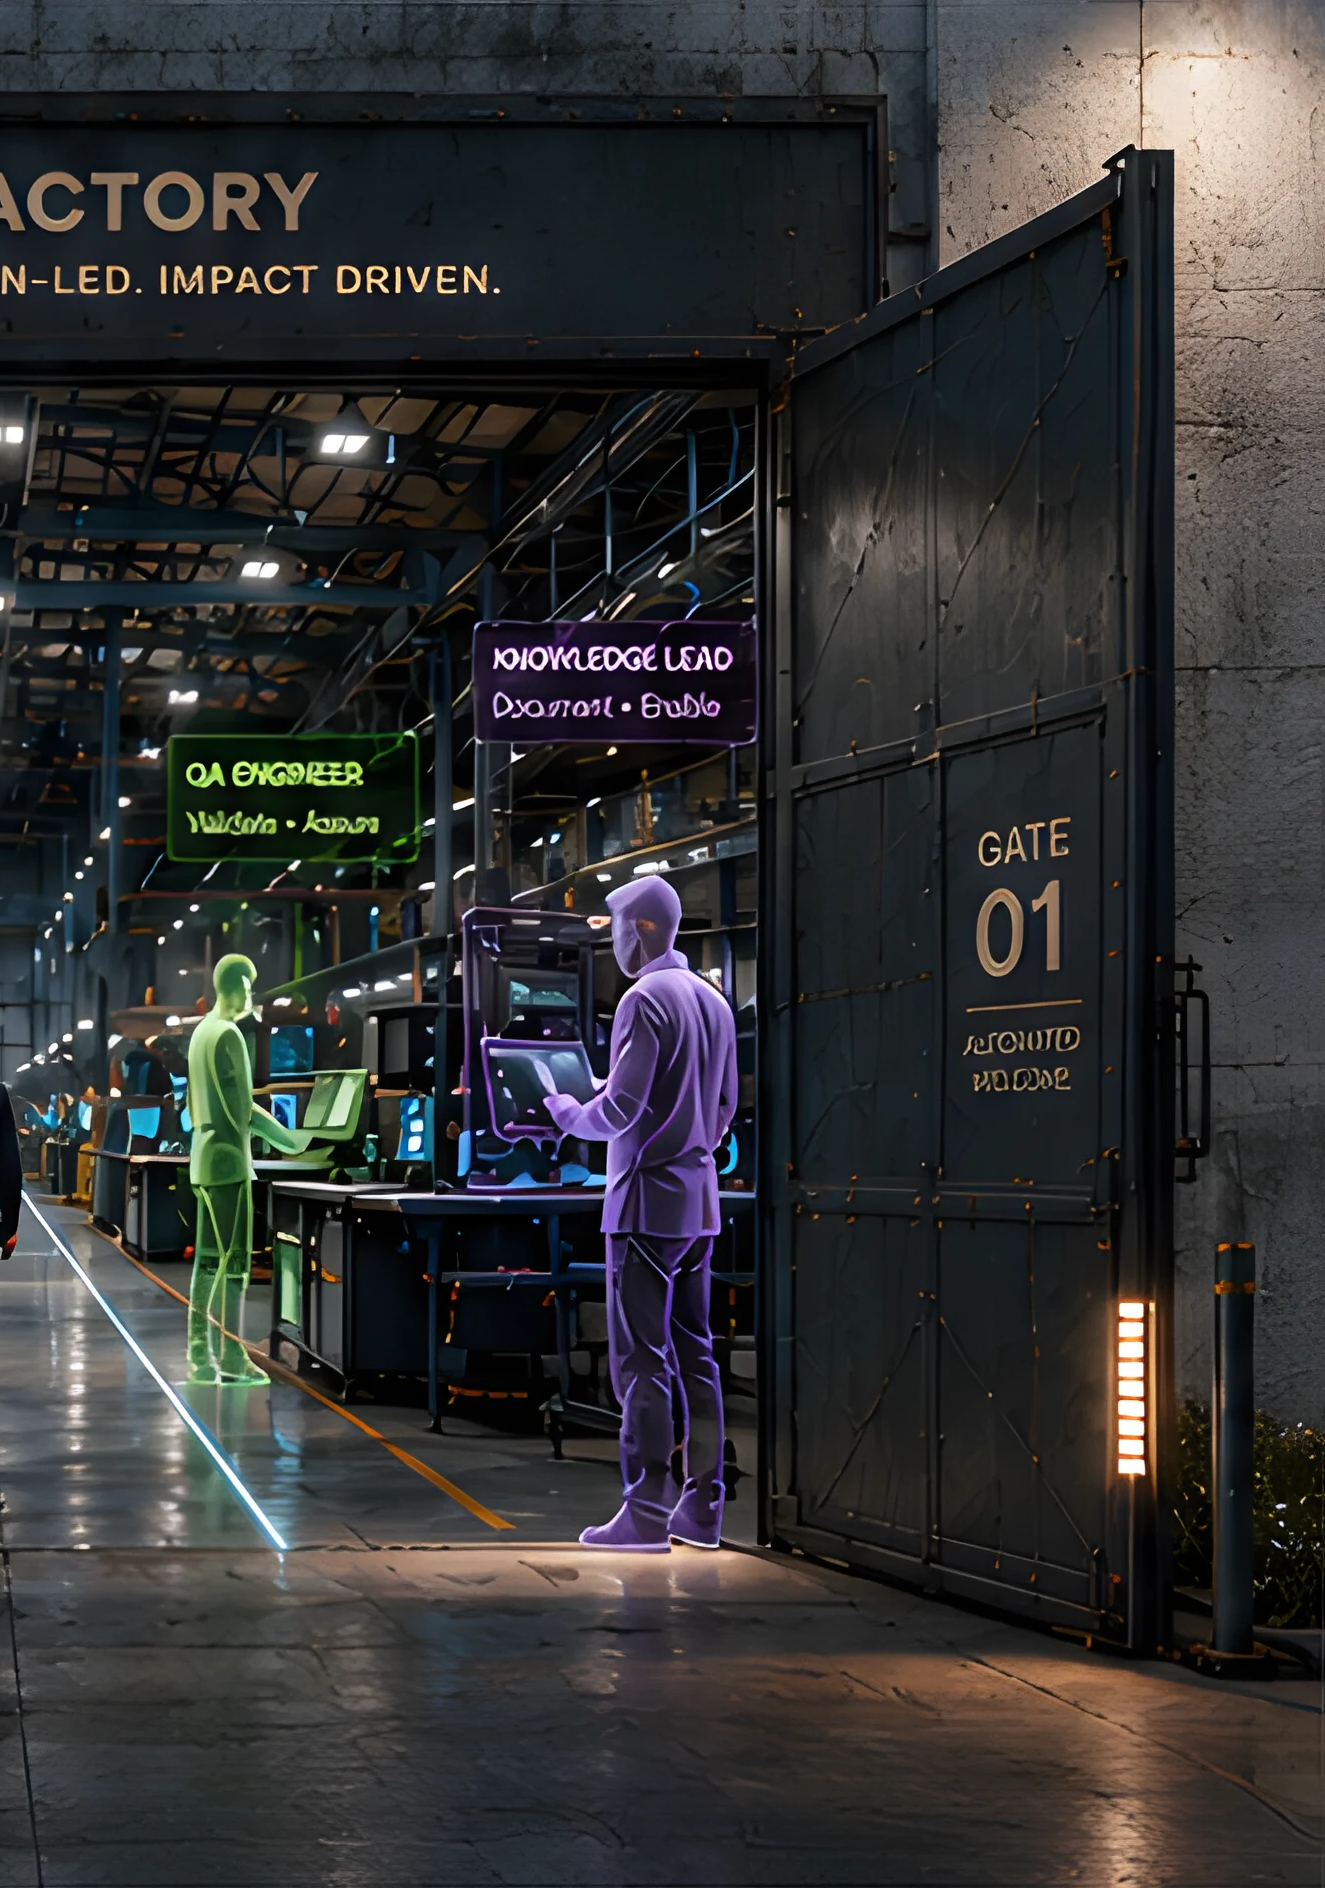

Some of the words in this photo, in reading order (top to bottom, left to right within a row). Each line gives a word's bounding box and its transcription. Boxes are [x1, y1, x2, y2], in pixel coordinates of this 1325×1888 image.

[160, 264, 319, 295] IMPACT
[336, 264, 501, 295] DRIVEN.
[977, 816, 1072, 868] GATE
[975, 879, 1060, 978] 01
